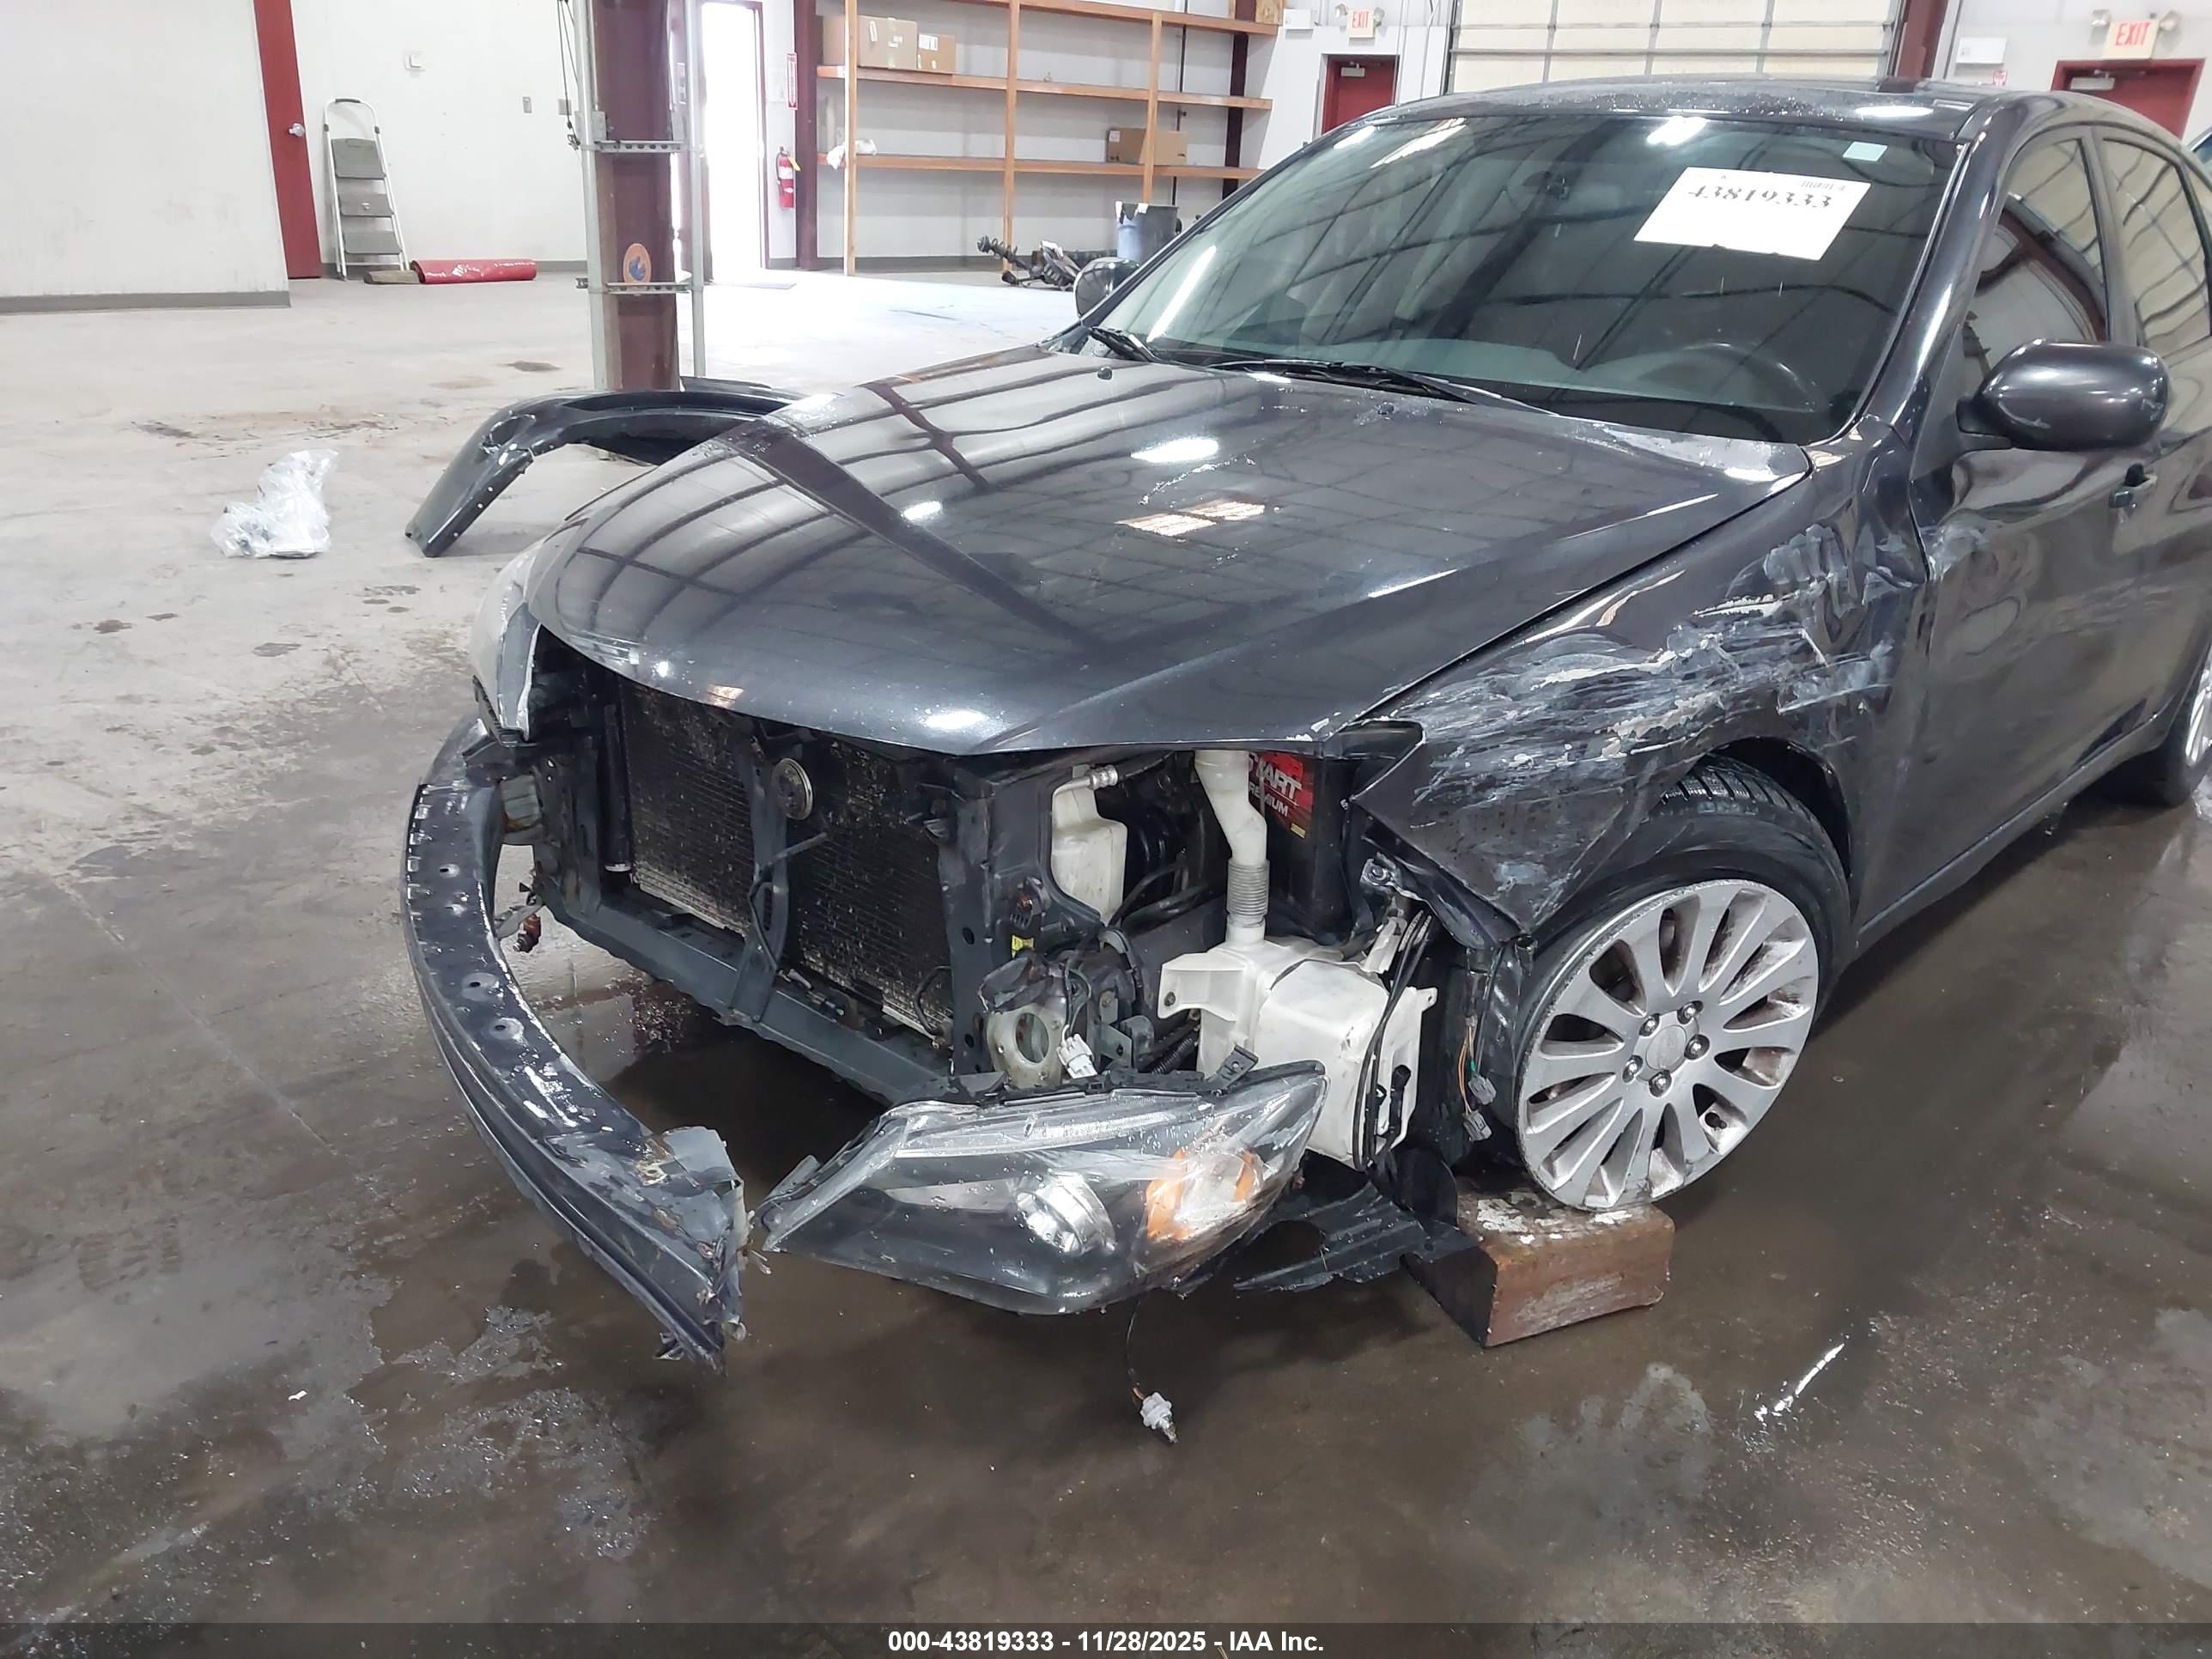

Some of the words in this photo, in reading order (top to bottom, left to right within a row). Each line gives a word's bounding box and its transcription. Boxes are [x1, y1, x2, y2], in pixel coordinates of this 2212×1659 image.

[1352, 10, 1370, 28] EXIT
[2115, 21, 2152, 46] EXIT
[1687, 185, 1832, 208] 43819333
[1249, 781, 1289, 817] REMIUM
